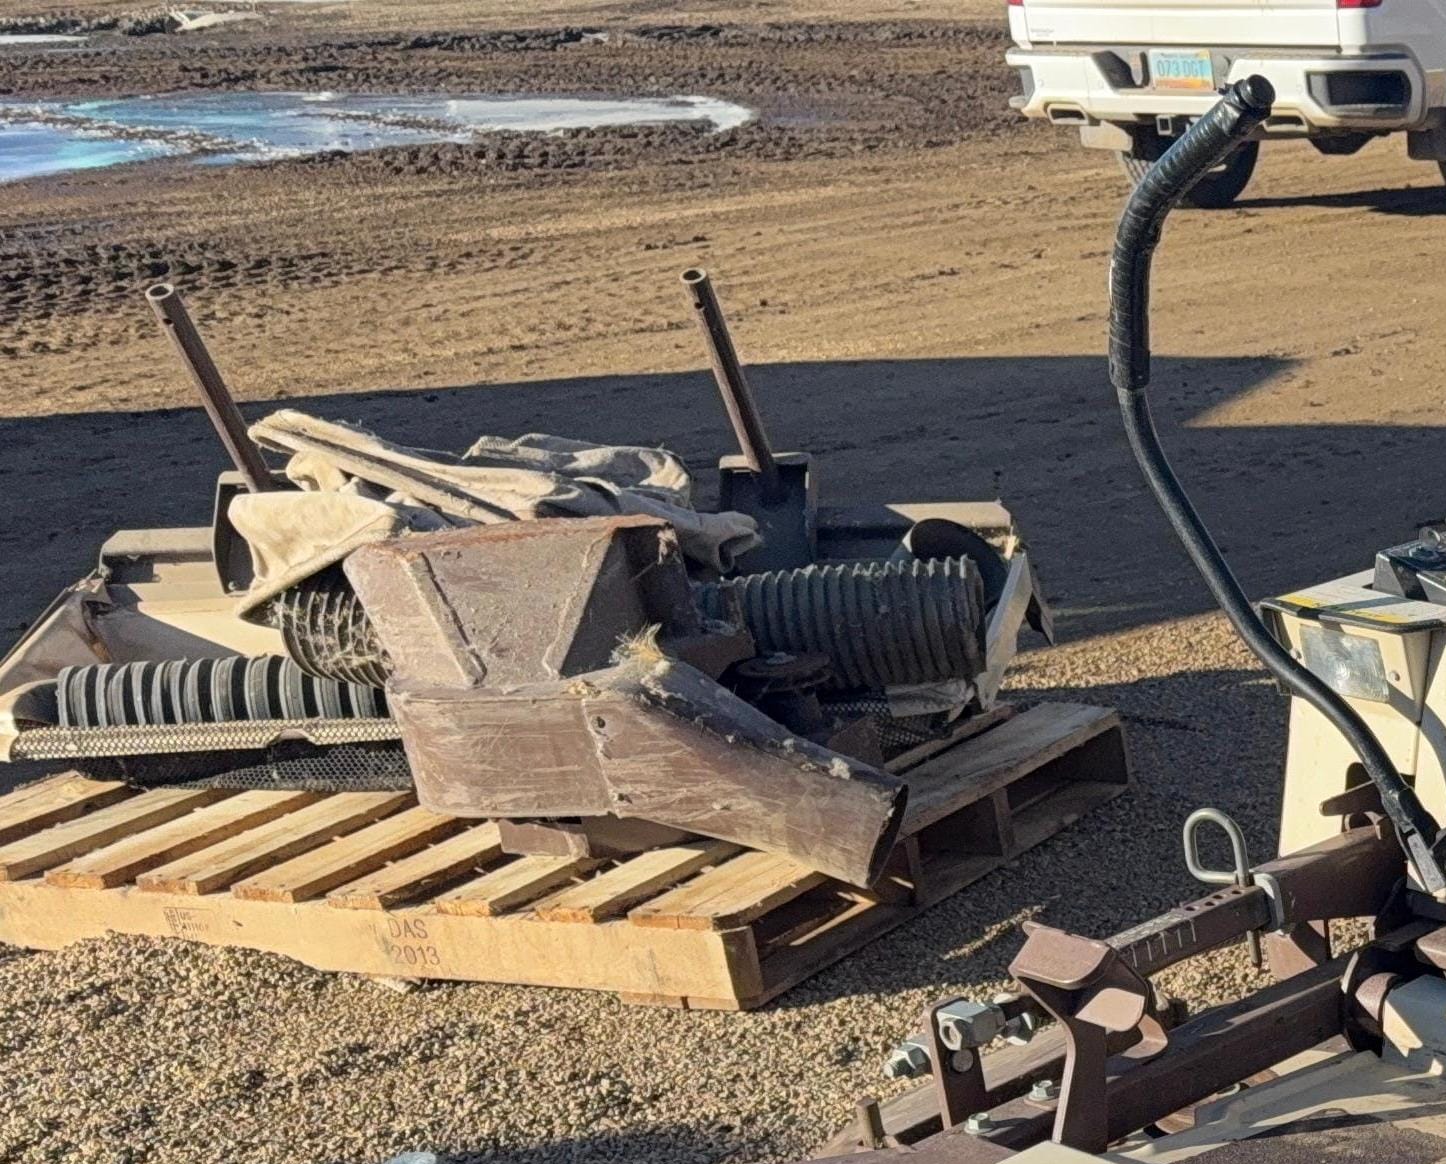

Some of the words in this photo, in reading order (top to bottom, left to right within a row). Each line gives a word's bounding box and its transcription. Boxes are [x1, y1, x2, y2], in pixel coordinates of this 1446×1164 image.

[1157, 59, 1180, 77] 073
[388, 918, 428, 939] DAS
[391, 945, 441, 966] 2013
